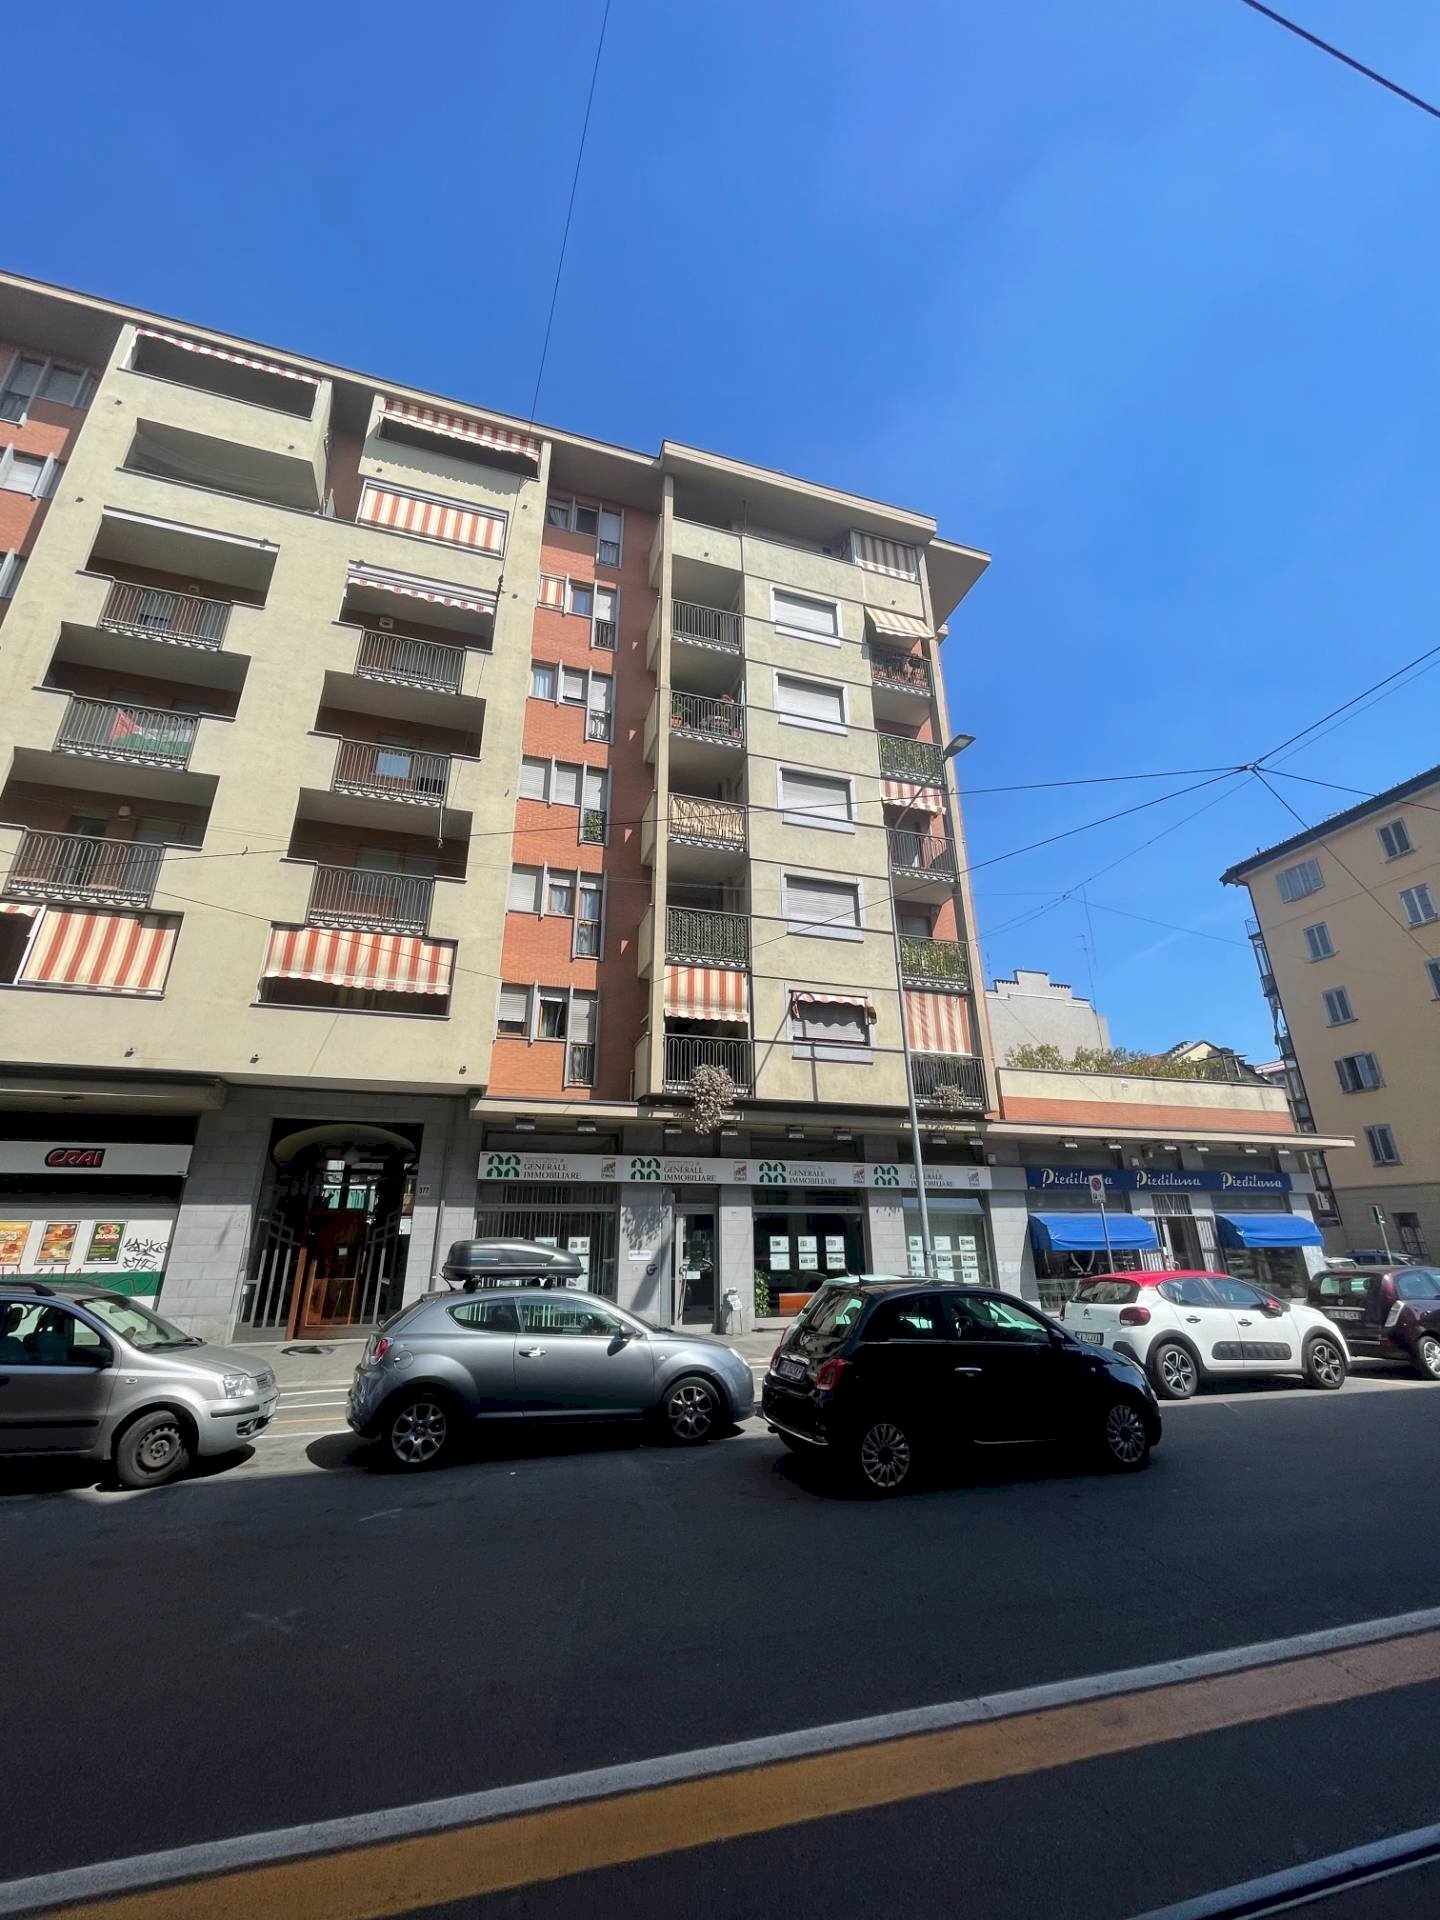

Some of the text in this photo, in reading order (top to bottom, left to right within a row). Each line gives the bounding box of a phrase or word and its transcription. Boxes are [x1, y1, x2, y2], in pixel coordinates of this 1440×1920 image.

[47, 1149, 104, 1167] CRAI
[523, 1163, 568, 1171] GENERALE
[523, 1171, 582, 1180] IMMOBILIARE
[788, 1169, 825, 1177] GENERALE
[663, 1174, 717, 1182] IMMOBILIARE
[789, 1177, 838, 1185] IMMOBILIARE
[1041, 1168, 1113, 1188] Piedilua
[1136, 1170, 1202, 1189] Piediluna
[1220, 1171, 1283, 1190] Piediluna
